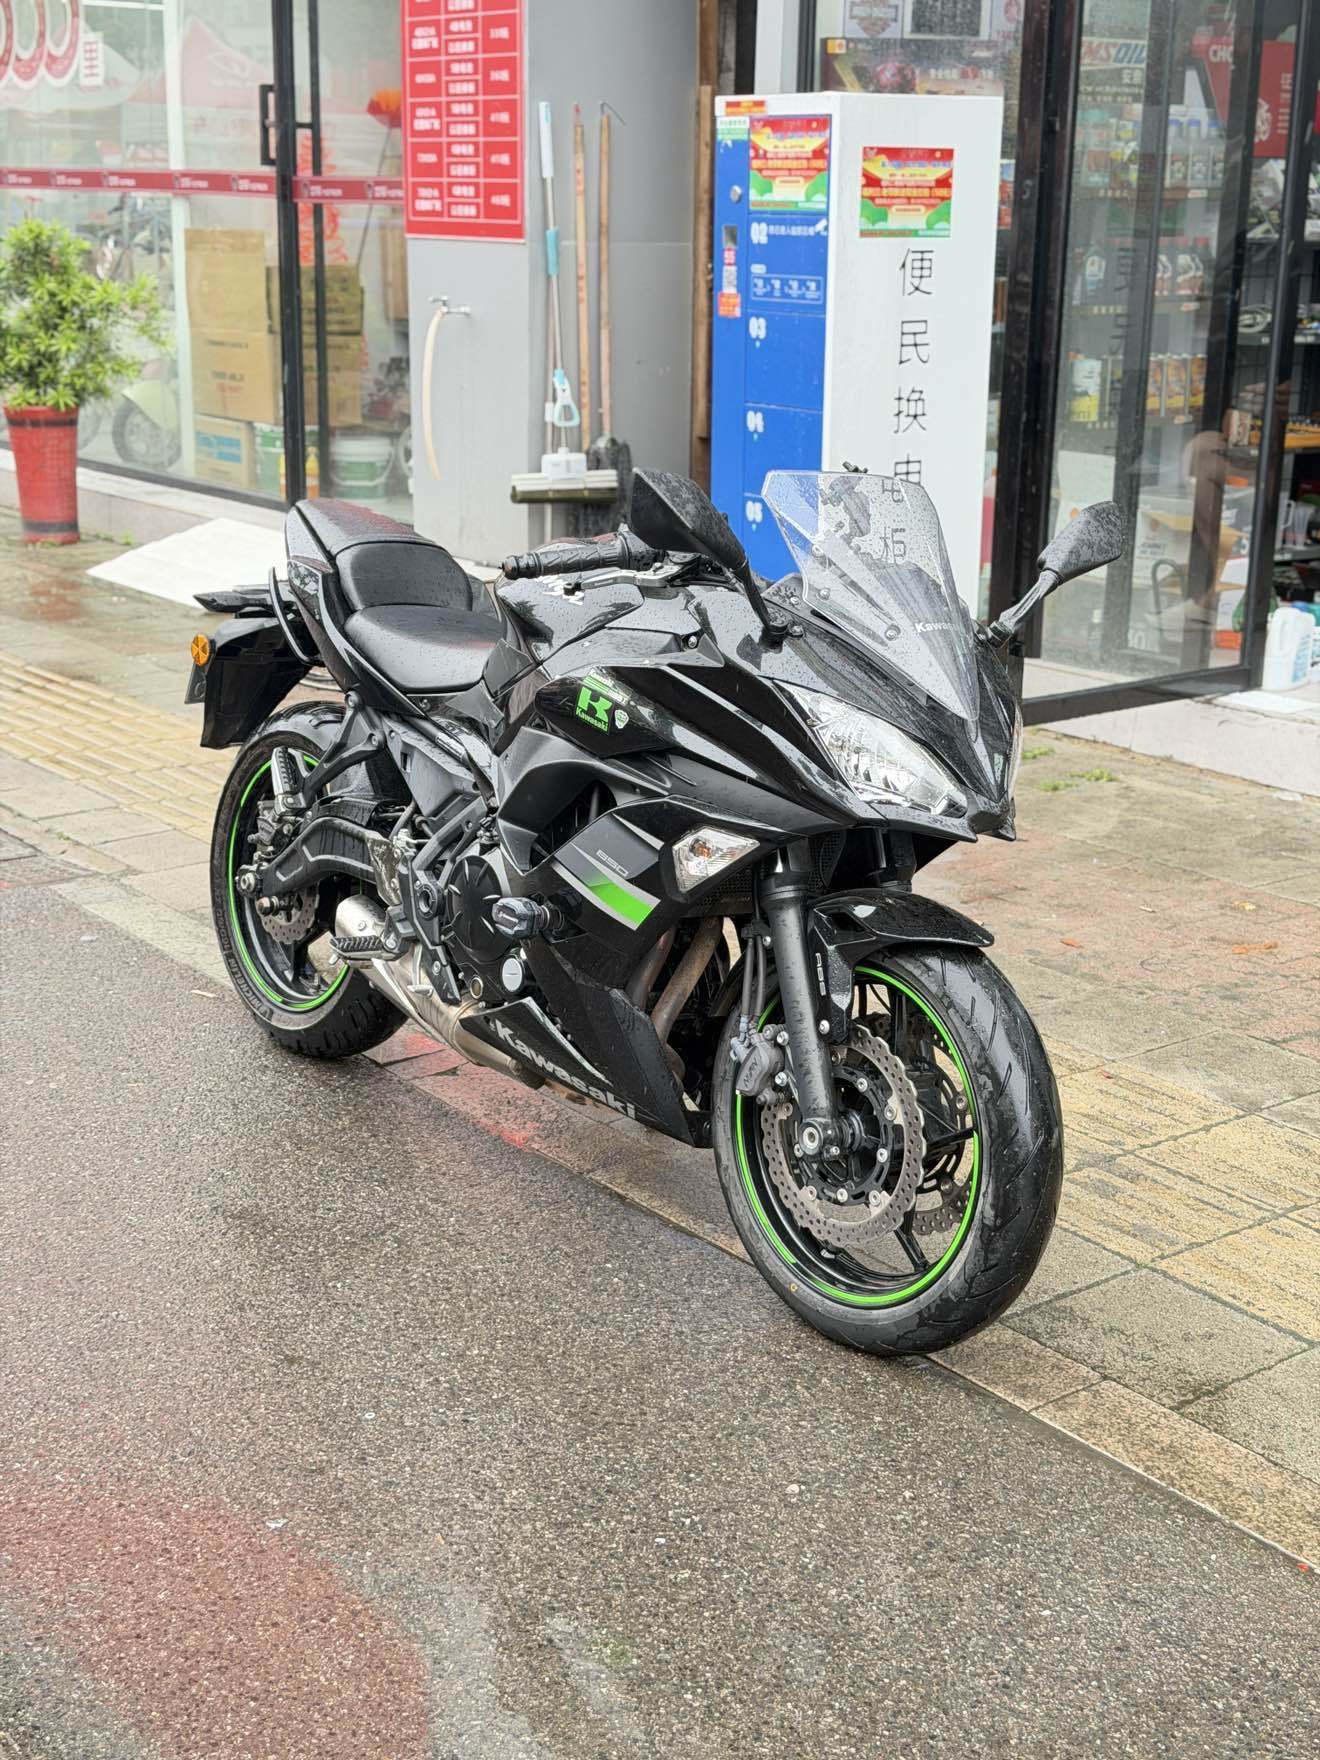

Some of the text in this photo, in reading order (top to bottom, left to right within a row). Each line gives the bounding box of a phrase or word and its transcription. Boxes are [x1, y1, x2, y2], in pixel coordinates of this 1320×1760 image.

[1079, 42, 1146, 64] MSOIL
[577, 708, 608, 732] Kawasaki
[494, 1019, 637, 1120] Kawasaki
